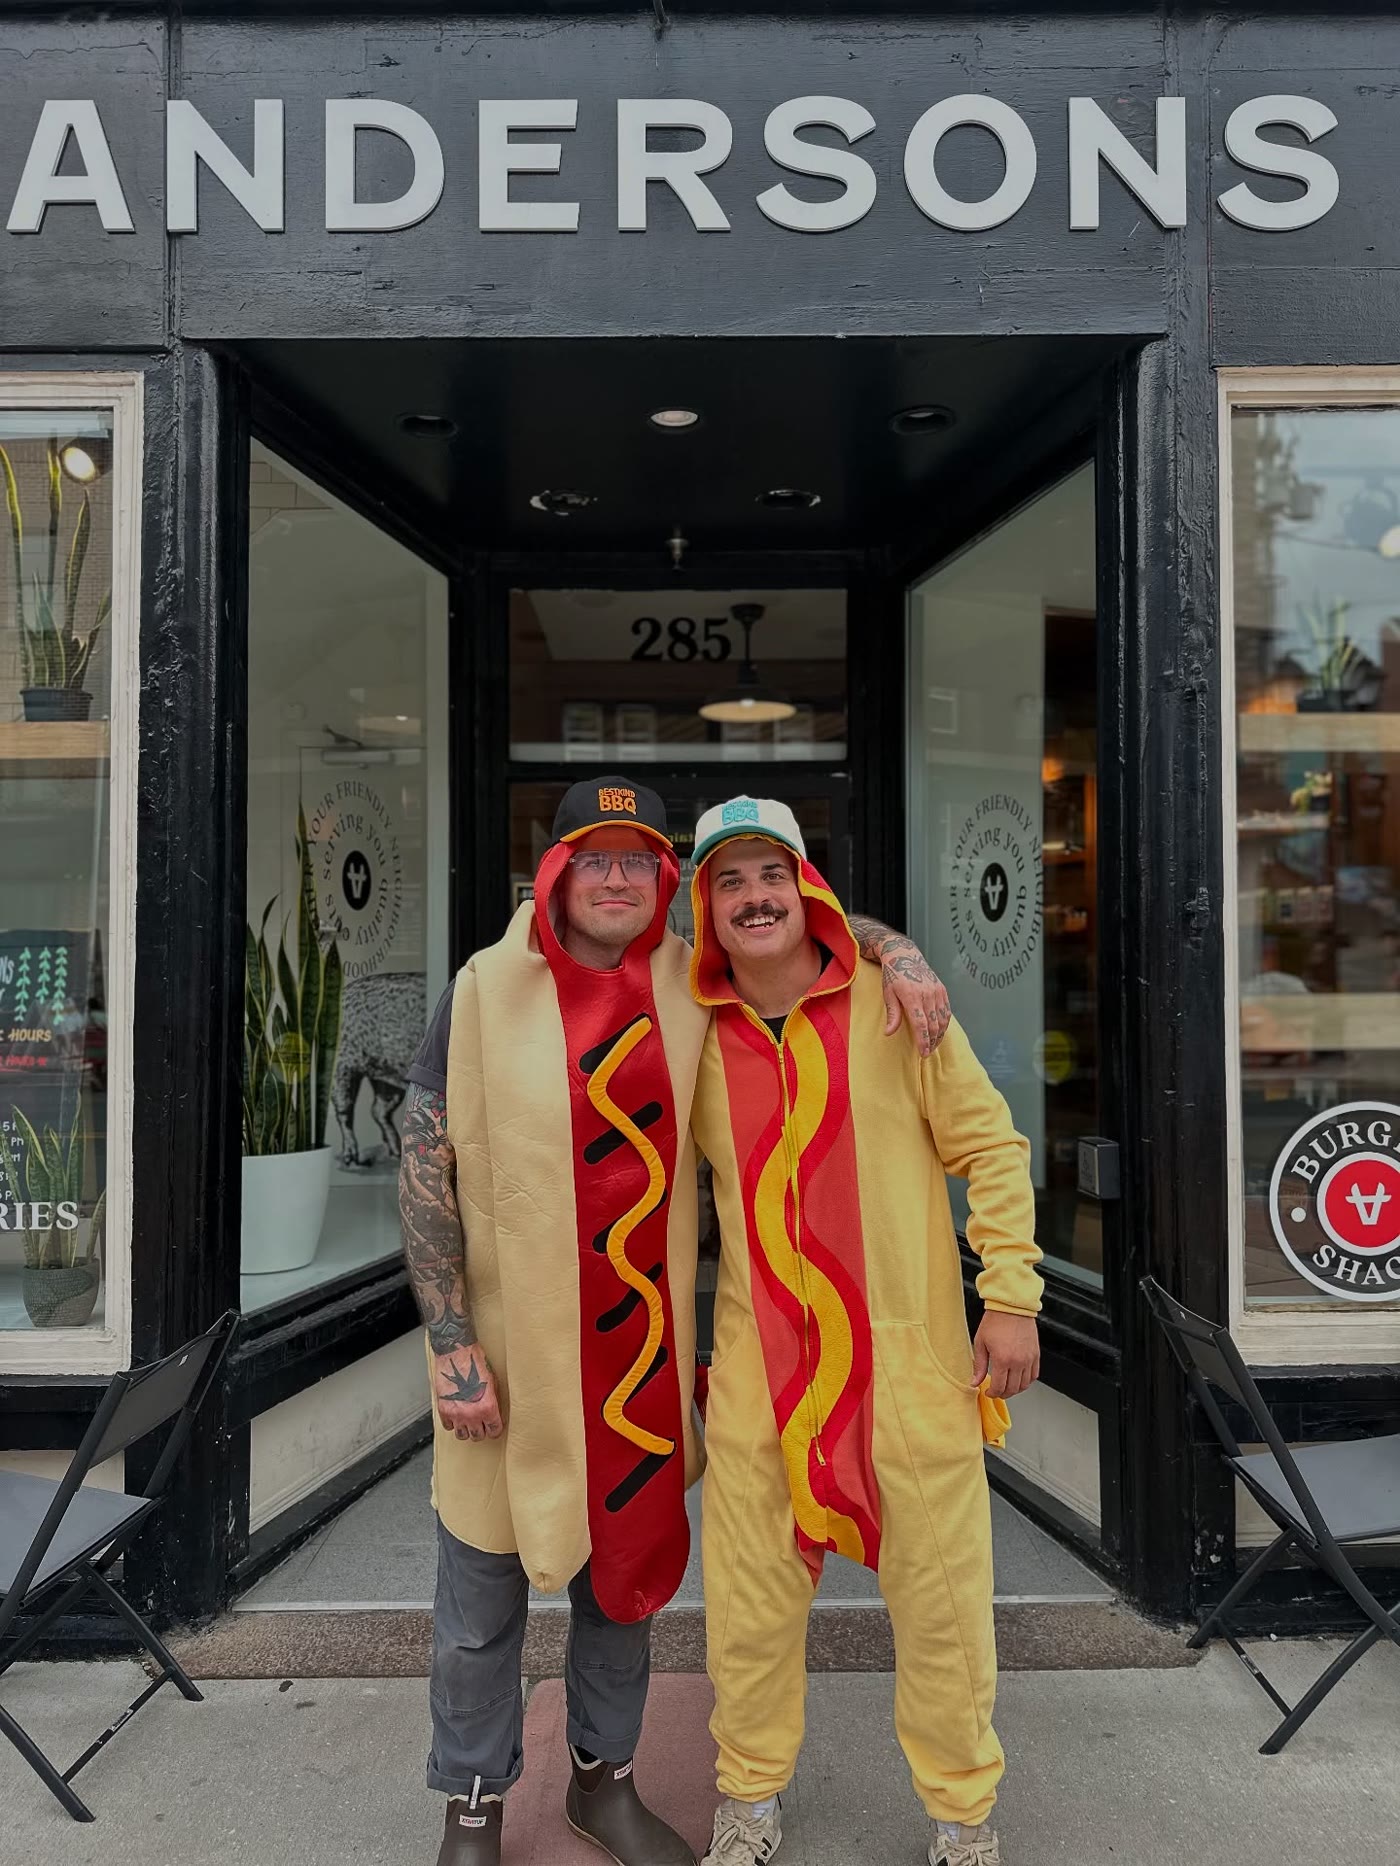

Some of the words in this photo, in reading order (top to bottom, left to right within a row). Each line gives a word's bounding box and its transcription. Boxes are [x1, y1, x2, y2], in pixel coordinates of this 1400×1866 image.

[5, 94, 1340, 233] ANDERSONS
[631, 616, 732, 663] 285
[307, 792, 335, 851] YOUR
[336, 781, 393, 830] FRIENDLY
[599, 795, 637, 815] BBQ
[722, 808, 759, 825] BBQ
[975, 794, 1033, 833] FRIENDLY
[323, 812, 363, 881] serving
[366, 823, 387, 866] you
[952, 817, 975, 871] YOUR
[963, 827, 1001, 898] serving
[1003, 833, 1025, 874] you
[354, 879, 389, 946] quality
[949, 885, 978, 979] BUTCHER
[965, 909, 987, 954] cuts
[991, 886, 1027, 957] quality
[8, 1028, 52, 1043] HOURS
[1290, 1120, 1400, 1184] BURG
